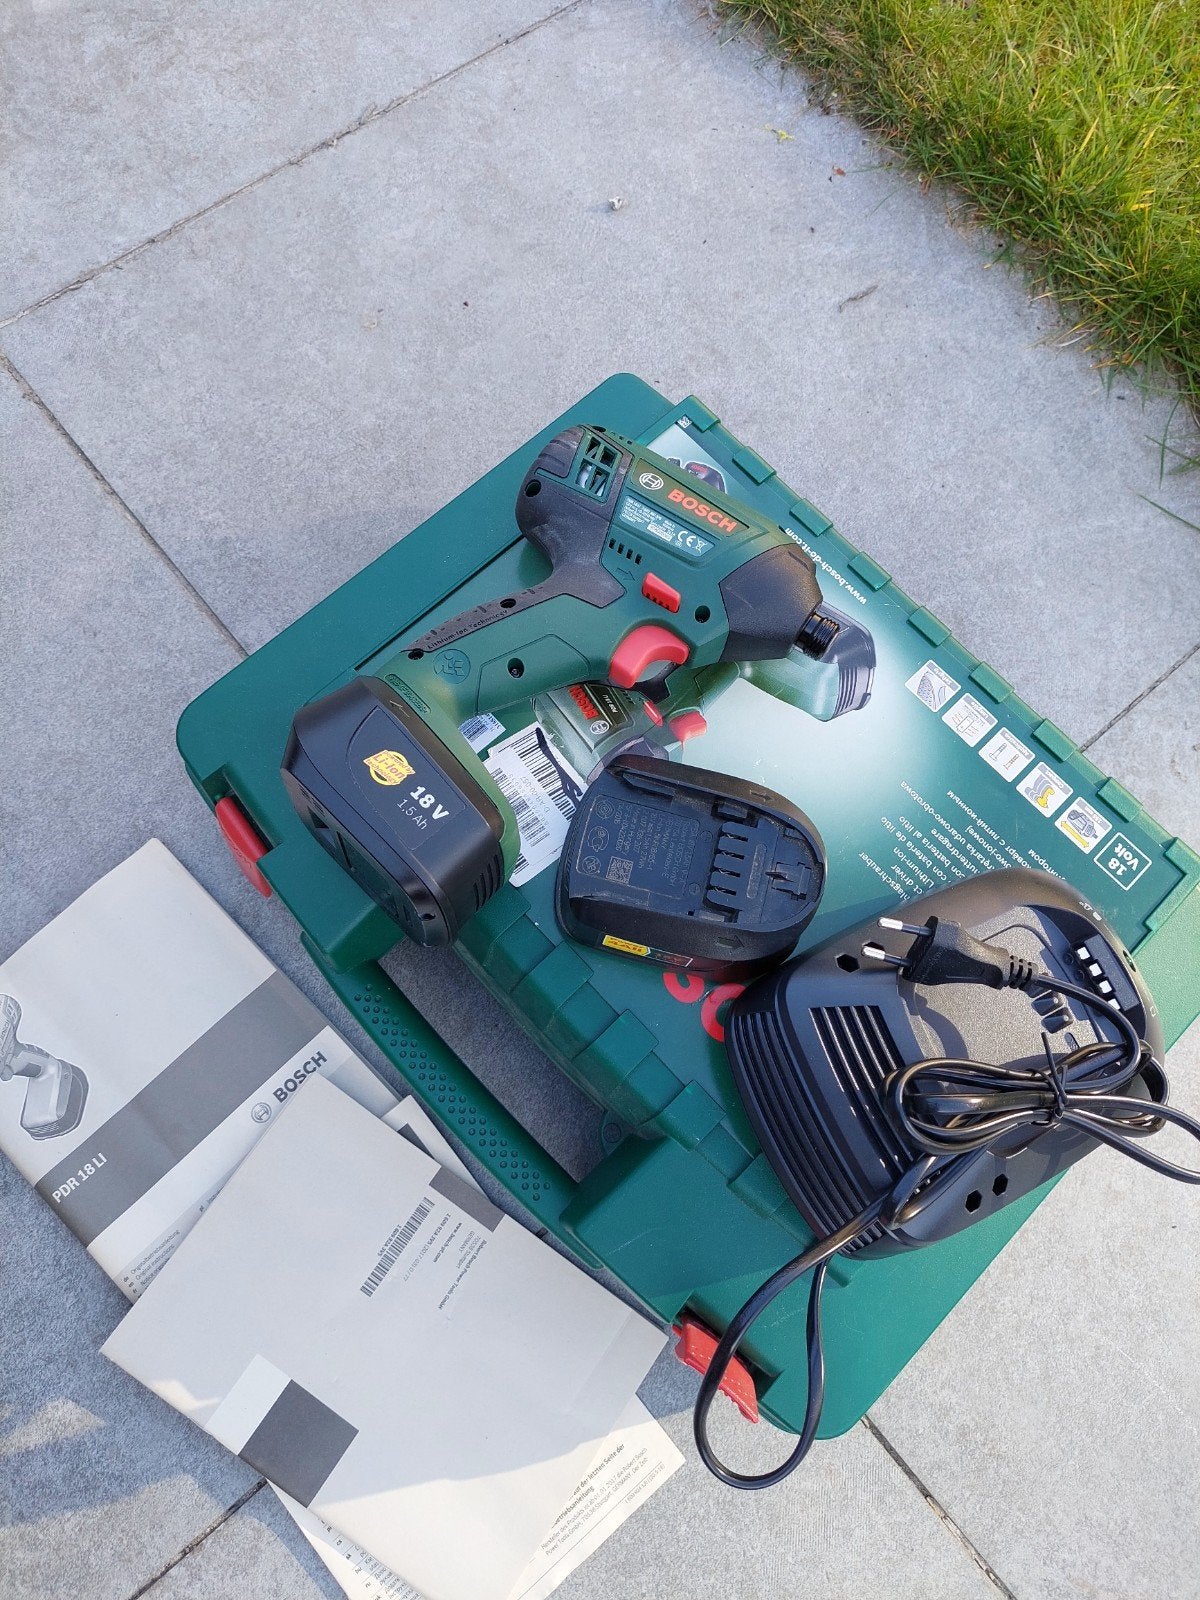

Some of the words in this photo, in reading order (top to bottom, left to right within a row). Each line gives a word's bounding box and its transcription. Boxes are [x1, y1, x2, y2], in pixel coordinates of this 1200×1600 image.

[667, 488, 740, 533] BOSCH
[783, 526, 868, 605] www.bosch-do-it.com
[372, 751, 406, 781] Li-Ion
[1044, 769, 1064, 788] Compact
[396, 796, 417, 818] 1,5
[411, 811, 428, 831] Ah
[408, 782, 436, 811] 18
[430, 802, 450, 825] V
[898, 780, 966, 844] udarowo-obrotowa
[945, 789, 1000, 842] литий-ионным
[896, 814, 914, 833] litio
[912, 829, 922, 840] al
[893, 829, 907, 844] de
[920, 836, 951, 867] batteria
[1112, 841, 1141, 870] Volt
[890, 862, 915, 886] driver
[891, 845, 934, 888] Lithium-Ion
[932, 864, 948, 880] con
[1106, 856, 1128, 877] 18
[272, 1050, 327, 1103] BOSCH
[51, 1175, 80, 1203] PDR
[76, 1162, 96, 1181] 18
[91, 1152, 107, 1167] LI
[473, 1239, 487, 1256] Robert
[464, 1253, 477, 1269] Bosch
[454, 1267, 467, 1283] Power
[446, 1282, 458, 1296] Tools
[436, 1293, 450, 1310] GmbH
[603, 1450, 617, 1464] Seite
